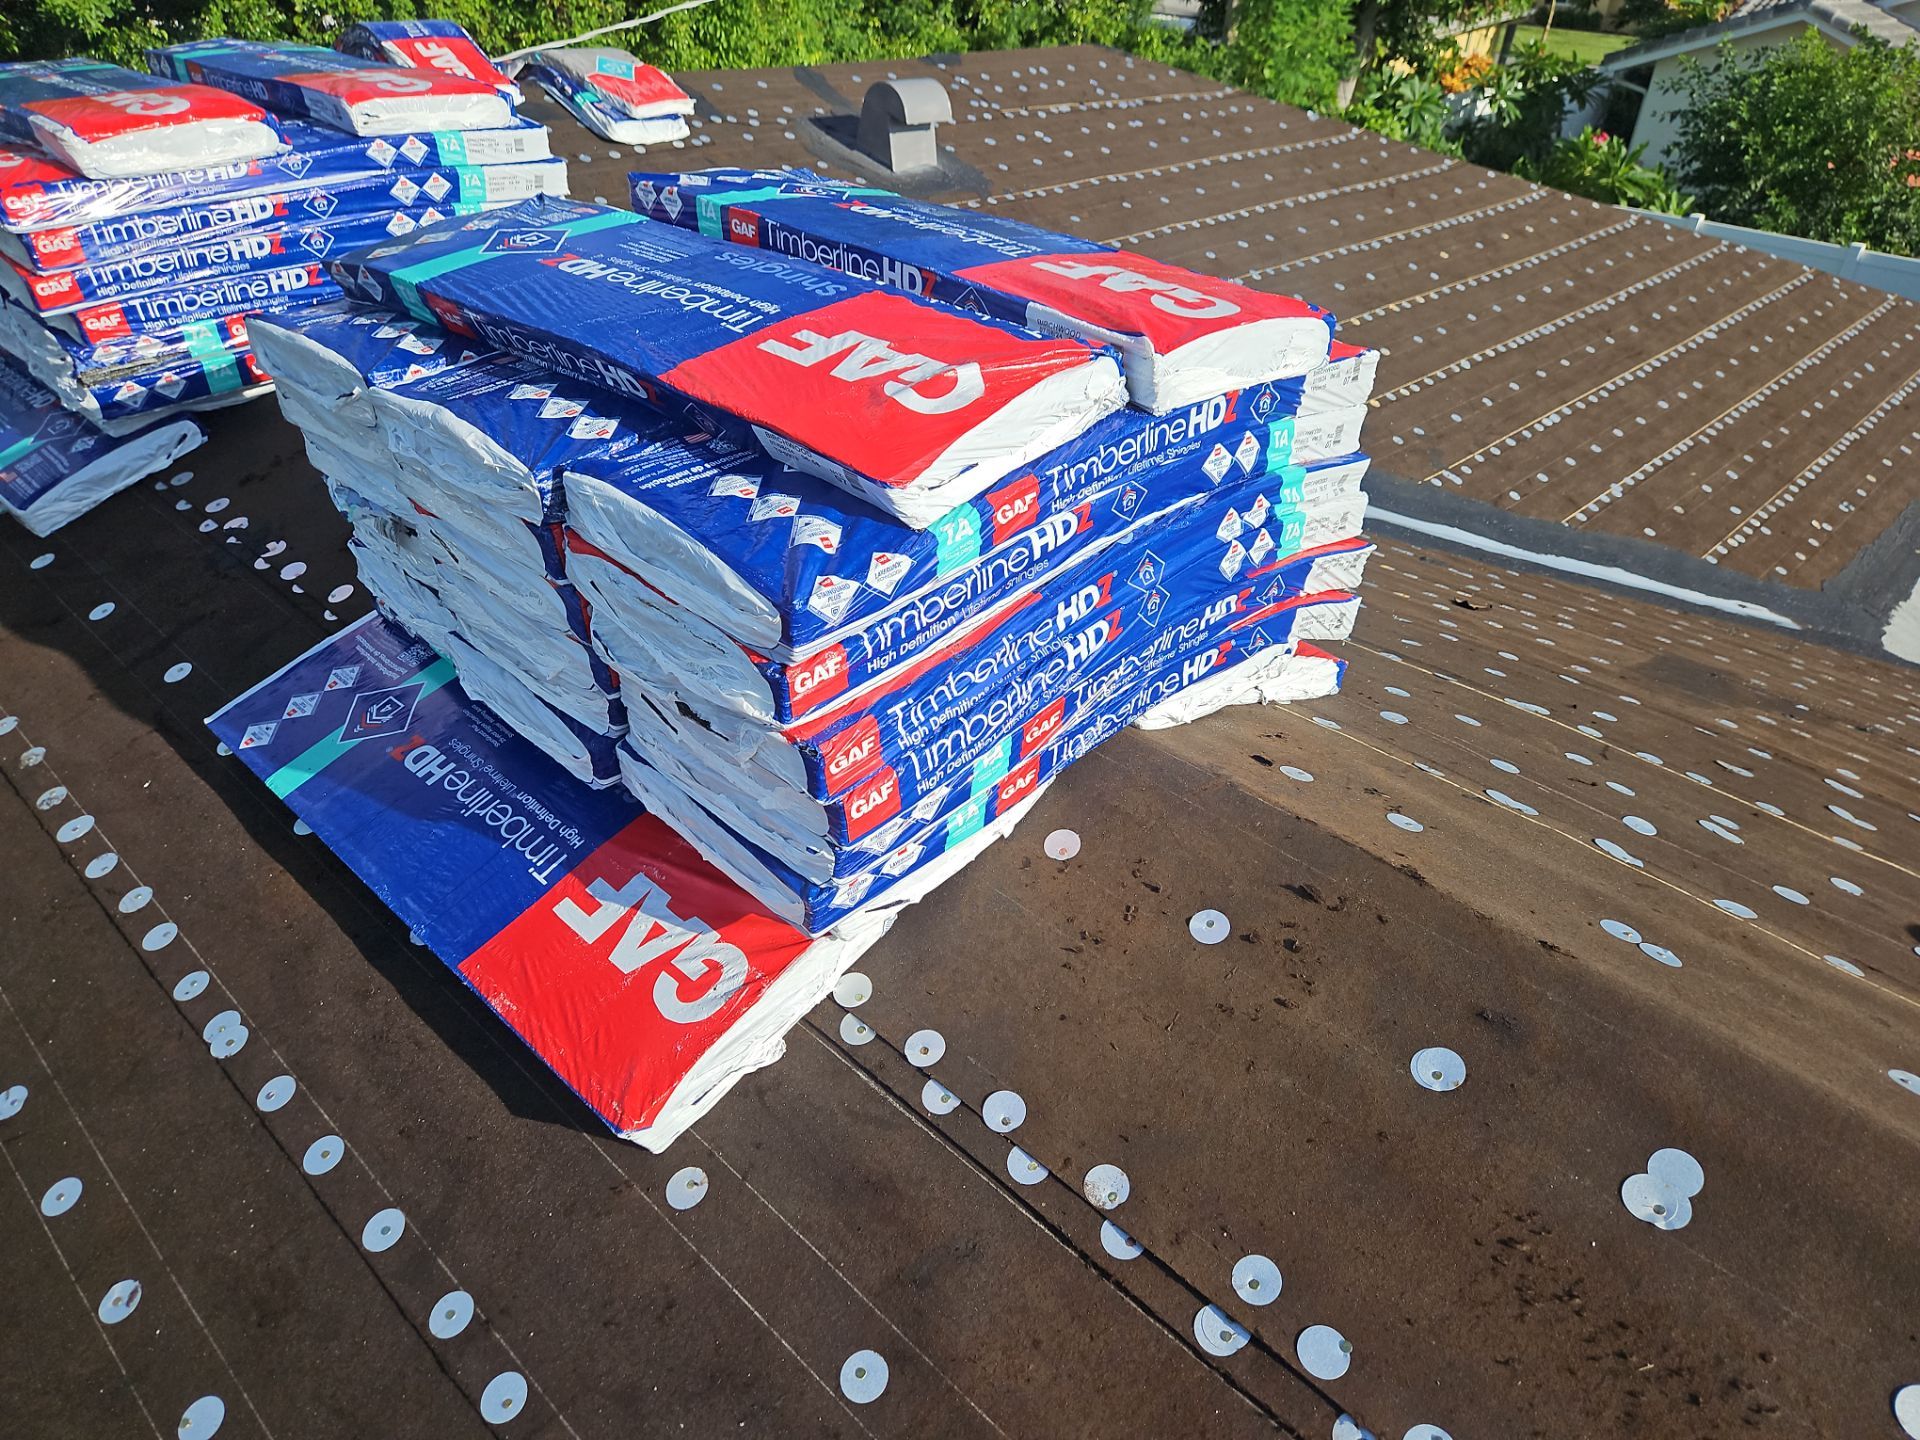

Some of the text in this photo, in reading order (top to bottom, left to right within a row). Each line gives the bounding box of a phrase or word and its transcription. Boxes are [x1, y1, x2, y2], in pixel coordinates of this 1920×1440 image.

[414, 41, 475, 80] AF
[440, 137, 460, 151] TA
[463, 174, 482, 188] TA
[731, 218, 757, 239] GAF
[37, 236, 76, 254] GAF
[35, 278, 74, 297] GAF
[715, 250, 848, 297] Shingles
[96, 284, 117, 297] High
[1030, 260, 1241, 319] GAF
[85, 313, 122, 331] GAF
[144, 318, 168, 332] High
[168, 310, 213, 328] Definition
[756, 328, 987, 415] GAF
[1273, 428, 1290, 449] TA
[689, 464, 705, 476] de
[996, 492, 1037, 525] GAF
[940, 518, 974, 546] TA
[1284, 522, 1301, 541] TA
[827, 592, 843, 603] PLUS
[867, 649, 897, 674] High
[899, 615, 957, 656] Definition
[793, 656, 843, 695] GAF
[897, 725, 929, 751] High
[930, 691, 985, 729] Definition
[1025, 710, 1062, 744] GAF
[828, 732, 876, 776] GAF
[446, 732, 587, 850] High Definition Lifetime Shingles
[916, 769, 945, 796] High
[1001, 768, 1037, 800] GAF
[850, 779, 895, 820] GAF
[551, 871, 751, 1024] GAF
